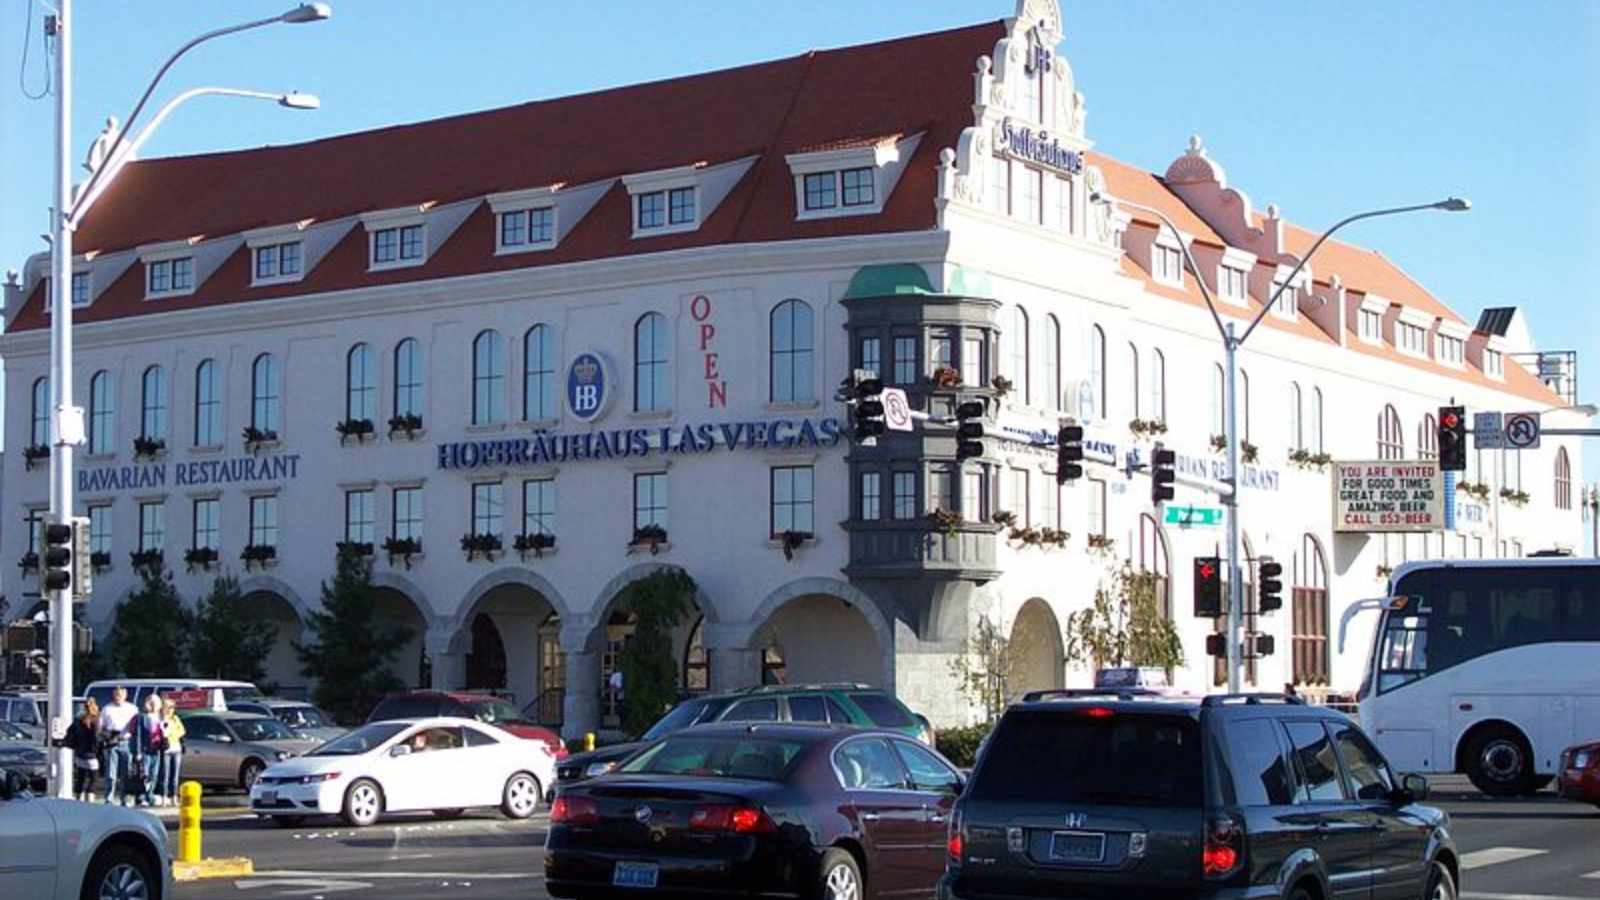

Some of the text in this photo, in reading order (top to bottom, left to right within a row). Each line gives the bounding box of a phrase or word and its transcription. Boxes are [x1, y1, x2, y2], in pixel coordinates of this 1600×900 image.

[690, 294, 727, 409] OPEN
[575, 384, 597, 410] HB
[437, 418, 840, 470] HOFBRÄUHAUS LAS VEGAS
[78, 454, 300, 492] BAVARIAN RESTAURANT
[1340, 466, 1435, 477] YOU ARE INVITED
[1342, 478, 1431, 489] FOR GOOD TIMES
[1340, 490, 1435, 501] GREAT FOOD AND
[1347, 502, 1395, 512] AMAZING
[1345, 513, 1373, 524] CALL
